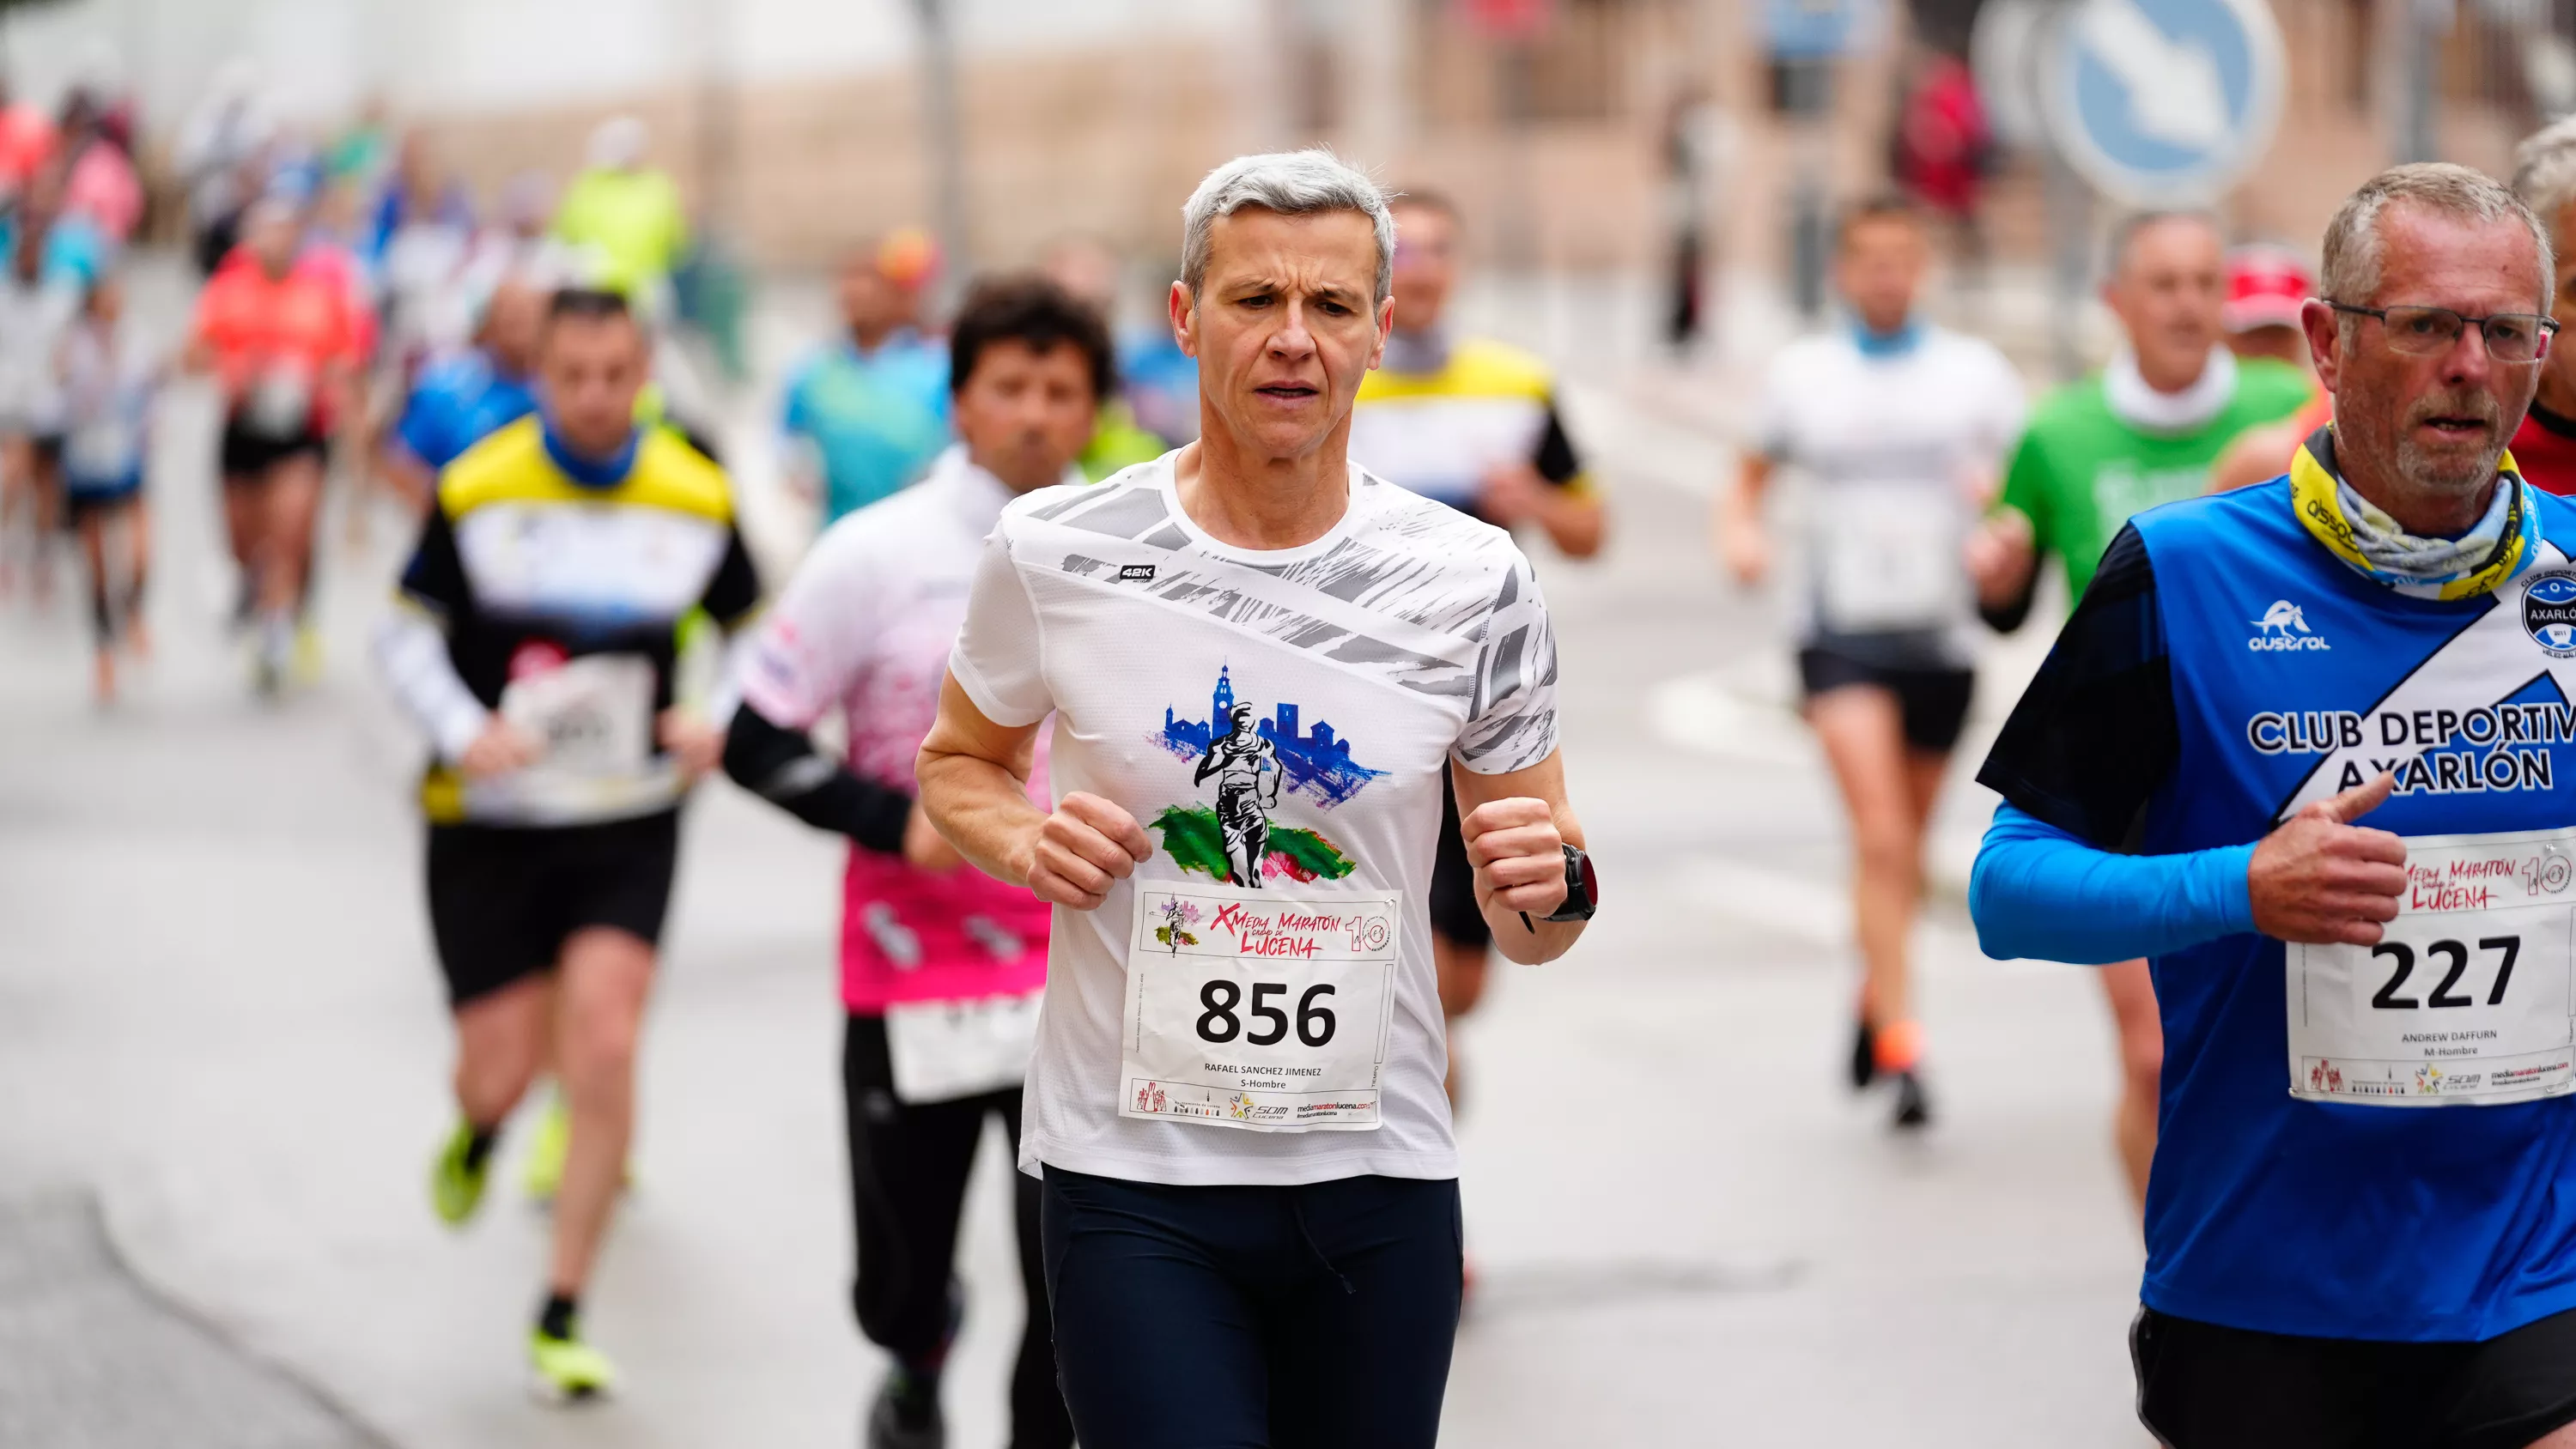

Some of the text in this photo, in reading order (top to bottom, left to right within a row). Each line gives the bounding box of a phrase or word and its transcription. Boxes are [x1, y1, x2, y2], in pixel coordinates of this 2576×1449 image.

[1122, 567, 1153, 577] 42K
[2248, 636, 2331, 652] austral
[2248, 712, 2362, 754] CLUB
[2449, 858, 2516, 880] MARATÓN
[2412, 885, 2500, 911] LUCENA
[1211, 902, 1341, 937] X MEDIA MARATÓN
[1241, 931, 1324, 959] LUCENA
[2372, 934, 2521, 1009] 227
[1195, 979, 1336, 1046] 856
[2402, 1030, 2497, 1043] ANDREW DAFFURN
[2424, 1046, 2478, 1056] M-Hombre
[1205, 1063, 1321, 1076] RAFAEL SANCHEZ JIMENEZ
[1241, 1079, 1286, 1089] S-Hombre
